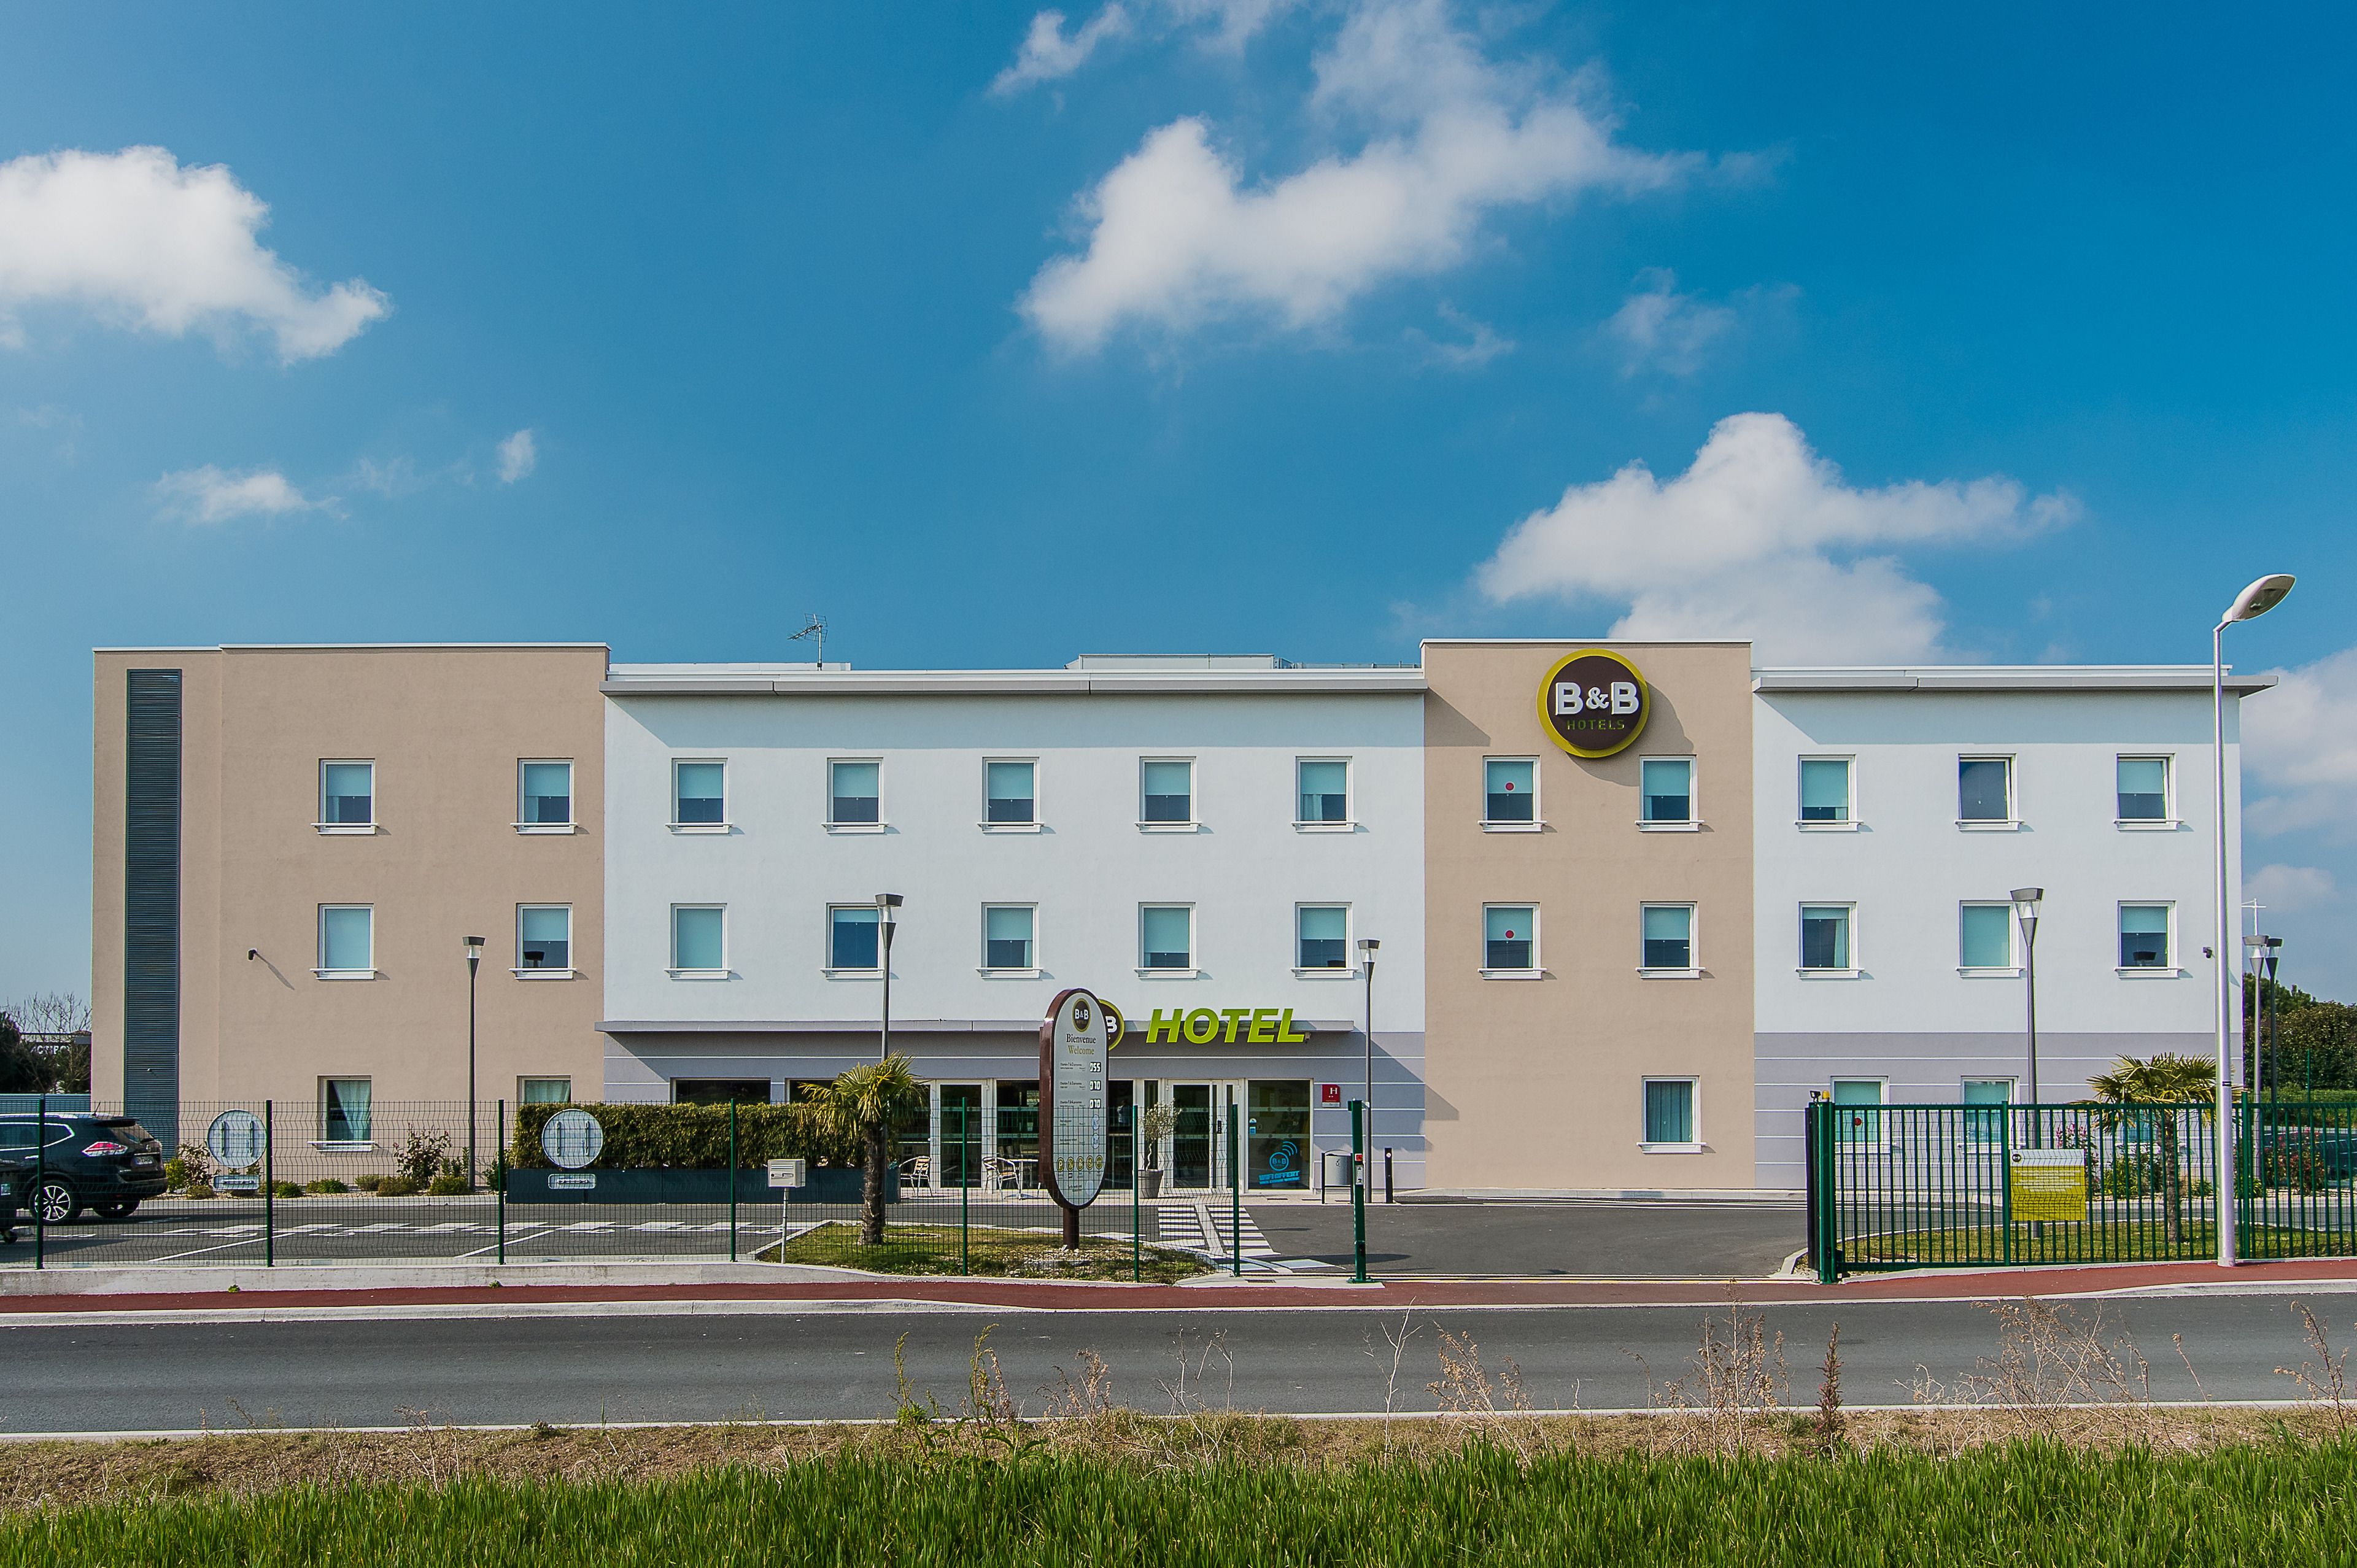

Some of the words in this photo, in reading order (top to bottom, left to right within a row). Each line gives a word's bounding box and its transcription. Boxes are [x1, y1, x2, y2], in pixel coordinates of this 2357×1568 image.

[1555, 682, 1639, 716] B&B
[1566, 719, 1625, 730] HOTELS
[1075, 1008, 1089, 1020] B&B
[1146, 1008, 1305, 1044] HOTEL
[1066, 1033, 1096, 1044] Bienvenue
[1068, 1045, 1095, 1055] Welcome
